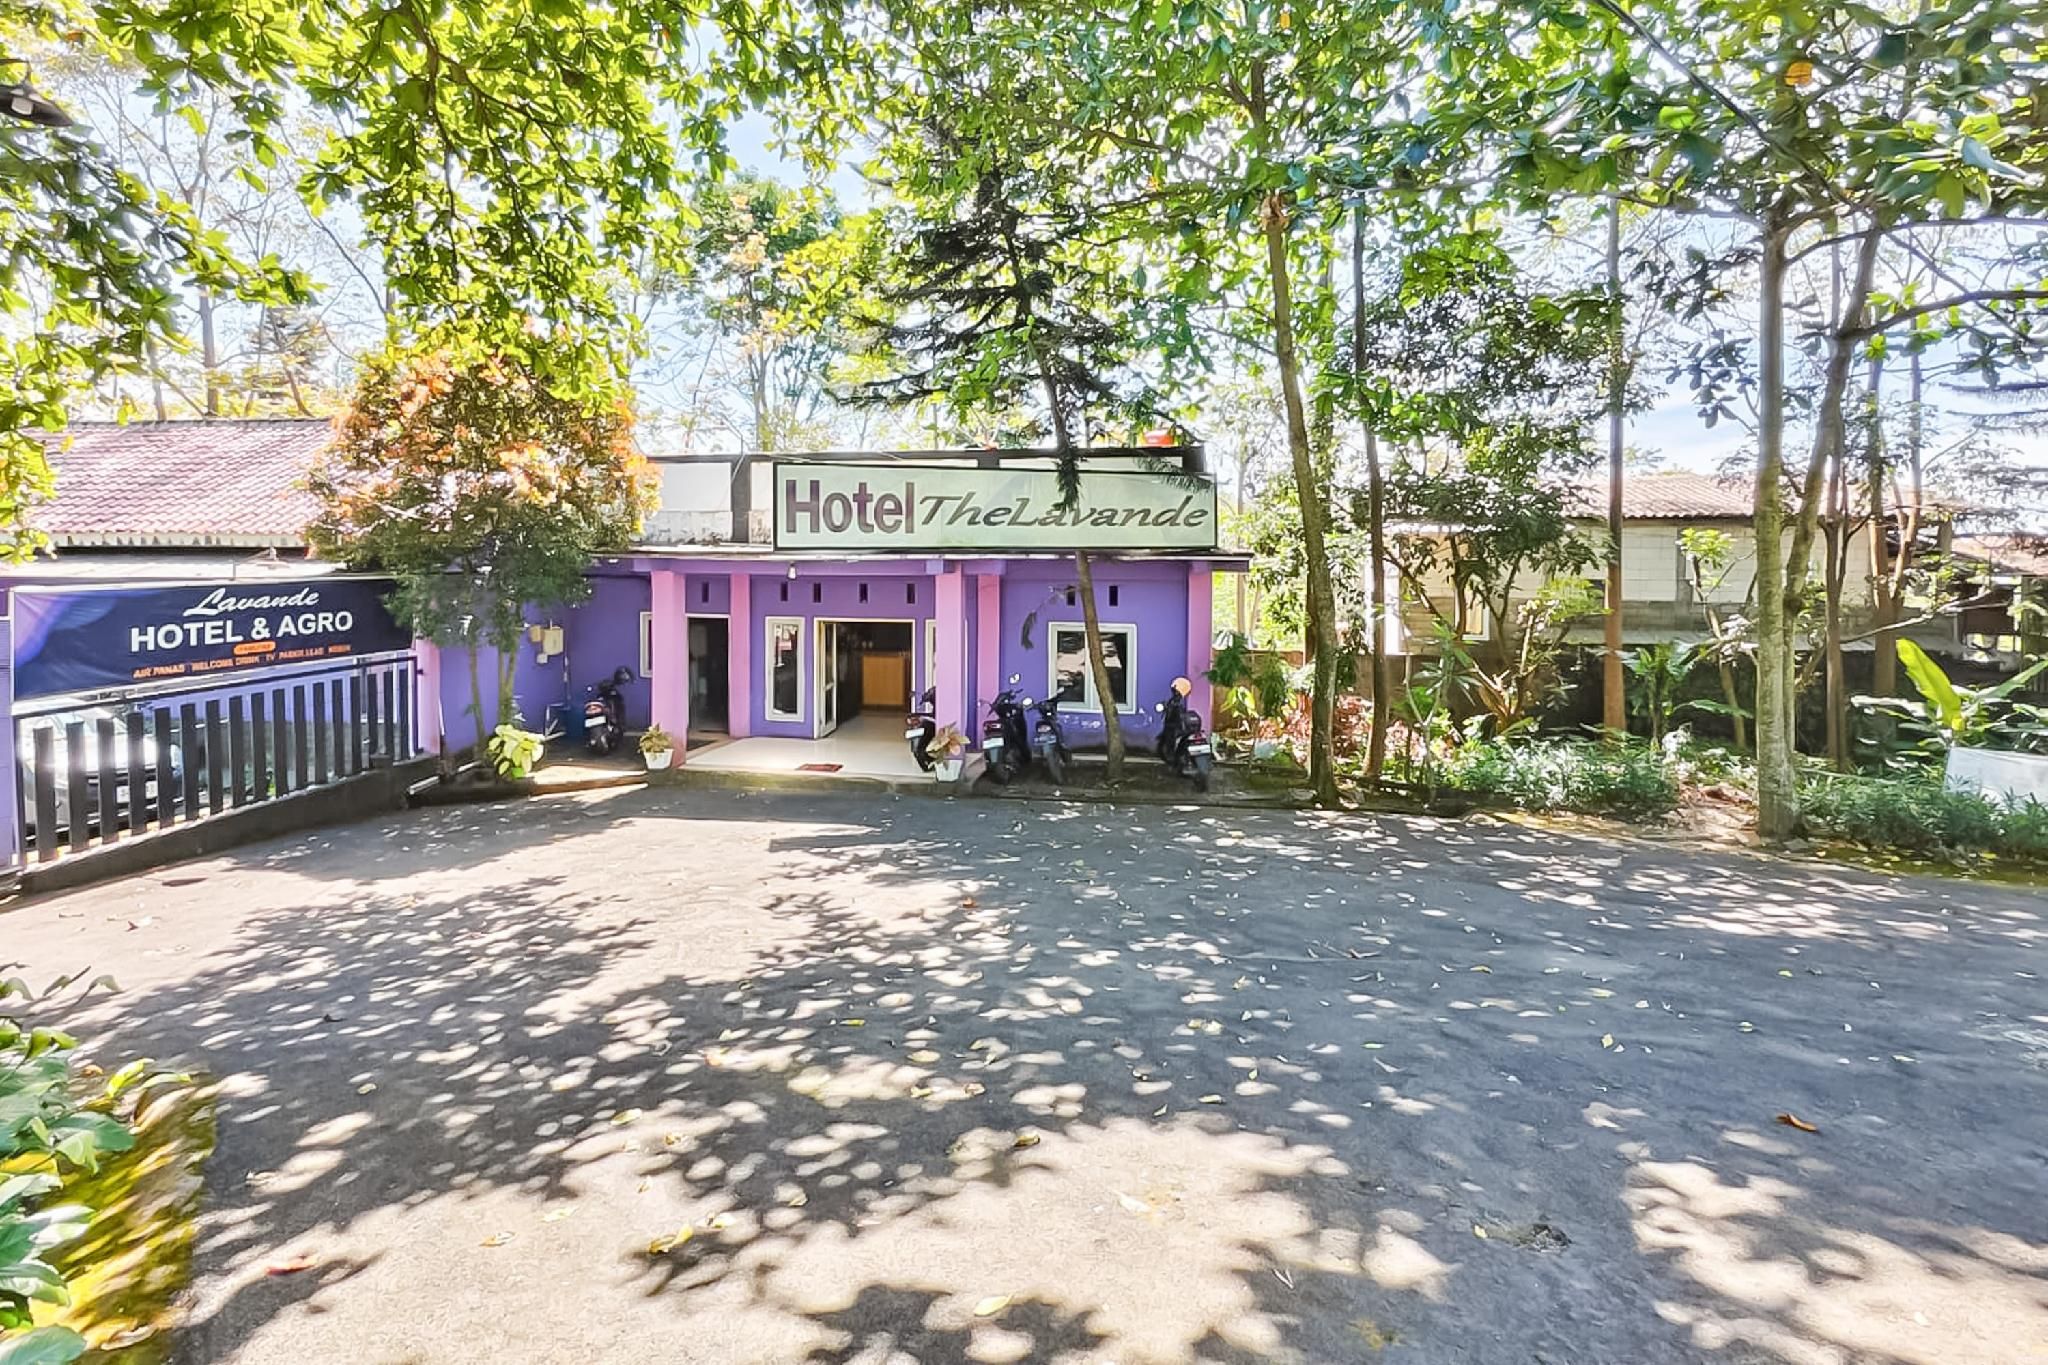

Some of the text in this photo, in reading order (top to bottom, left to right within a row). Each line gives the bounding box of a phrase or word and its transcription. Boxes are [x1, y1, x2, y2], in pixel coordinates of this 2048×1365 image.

[785, 479, 915, 533] Hotel
[183, 587, 320, 617] Lavande
[130, 610, 354, 653] HOTEL & AGRO
